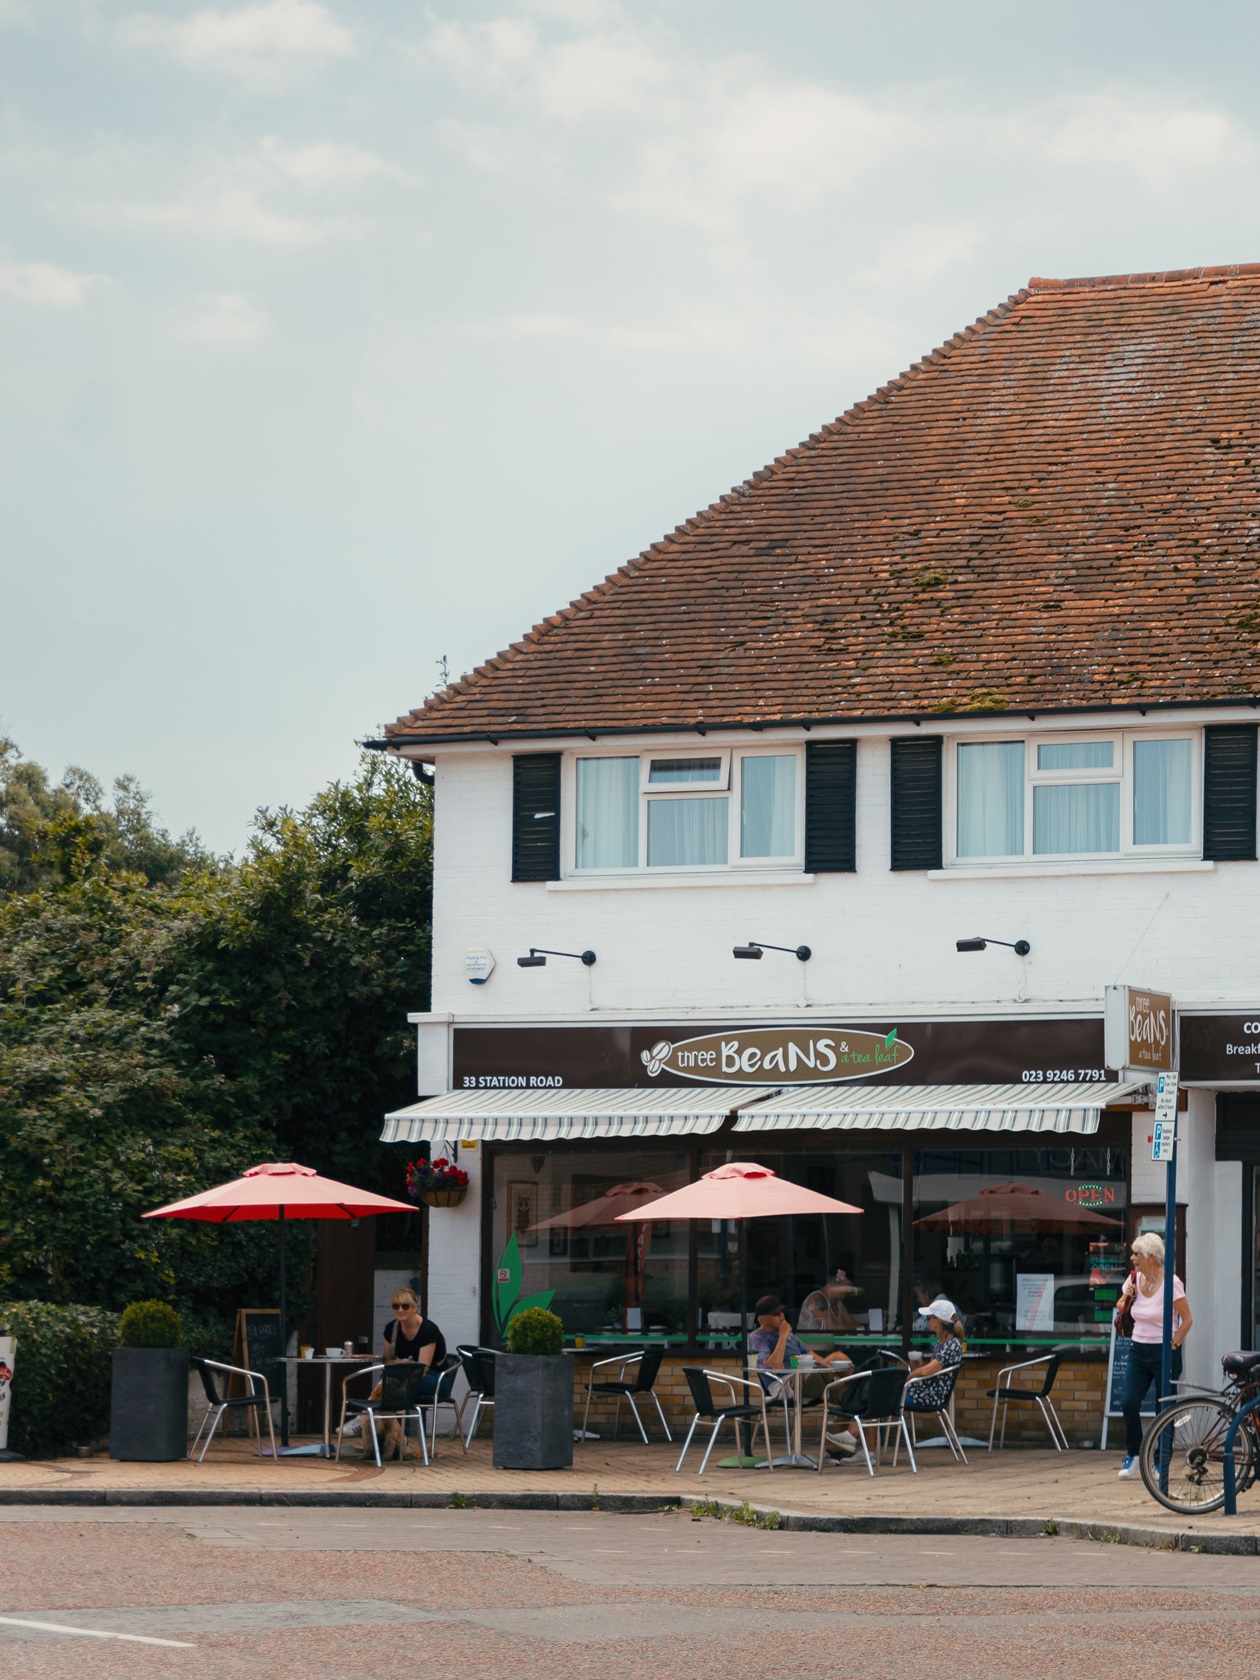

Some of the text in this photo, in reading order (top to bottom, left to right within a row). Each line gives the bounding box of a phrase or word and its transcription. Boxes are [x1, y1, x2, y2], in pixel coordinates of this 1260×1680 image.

[677, 1049, 716, 1067] three
[839, 1041, 849, 1053] &
[840, 1045, 901, 1066] a tea leaf
[463, 1076, 563, 1087] 33 STATION ROAD
[1022, 1069, 1106, 1082] 023 9246 7791
[1065, 1187, 1115, 1204] OPEN
